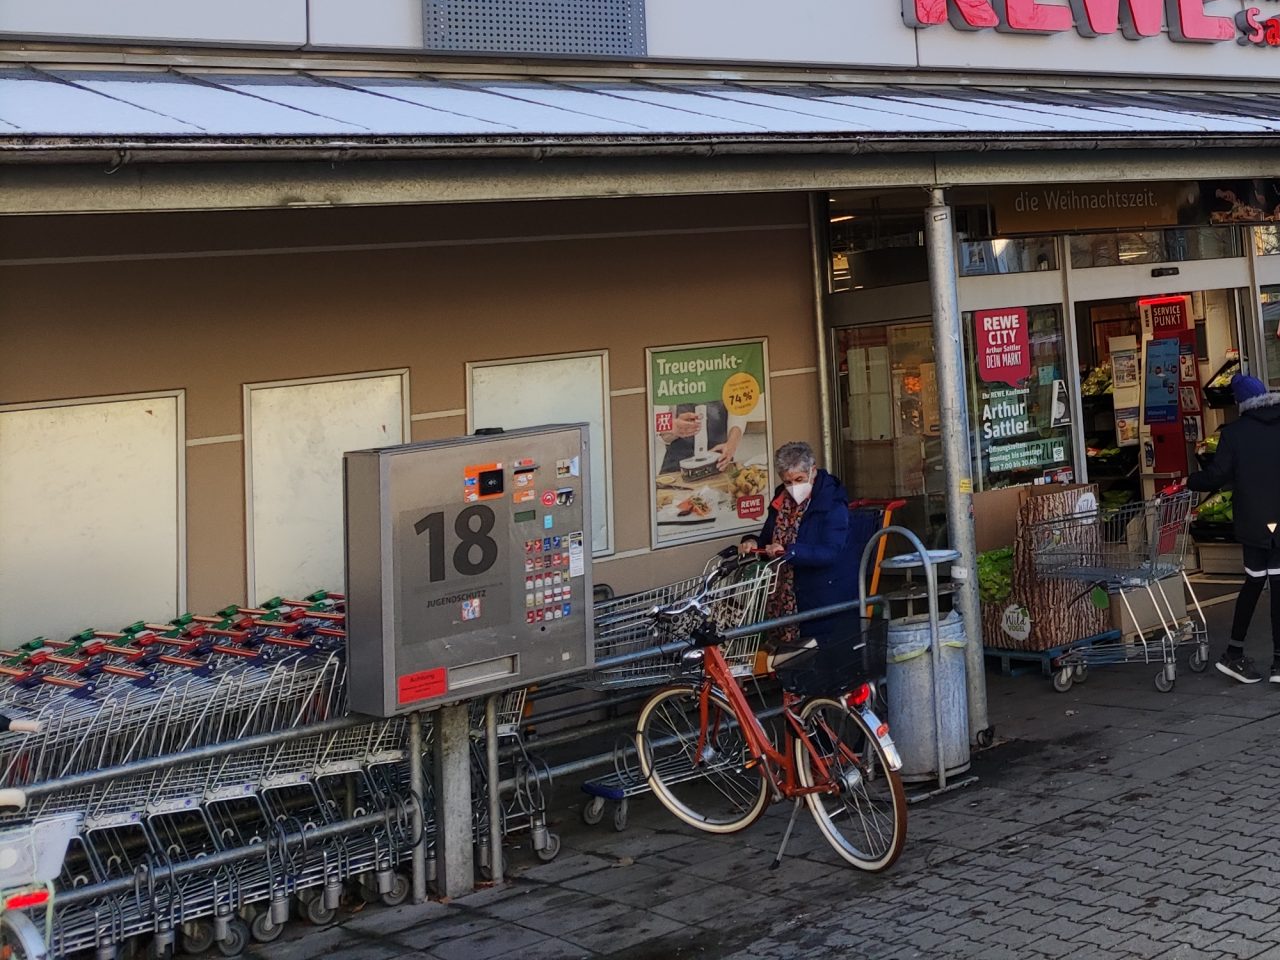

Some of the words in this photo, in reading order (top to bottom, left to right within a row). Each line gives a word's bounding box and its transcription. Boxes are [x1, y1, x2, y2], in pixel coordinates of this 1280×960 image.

[1015, 192, 1039, 212] die
[1043, 190, 1158, 210] Weihnachtszeit.
[1153, 305, 1181, 316] SERVICE
[983, 314, 1020, 331] REWE
[1153, 314, 1181, 327] PUNKT
[988, 329, 1017, 345] CITY
[656, 353, 743, 376] Treuepunkt-
[985, 354, 1001, 369] DEIN
[1002, 351, 1022, 367] MARKT
[657, 378, 707, 398] Aktion
[991, 390, 1005, 398] REWE
[728, 393, 742, 406] 74
[982, 401, 1025, 420] Arthur
[983, 418, 1029, 439] Sattler
[740, 498, 761, 508] REWE
[413, 504, 498, 583] 18
[427, 589, 486, 608] JUGENDSCHUTZ
[1005, 613, 1026, 626] Wild
[1007, 625, 1026, 633] VOGEL
